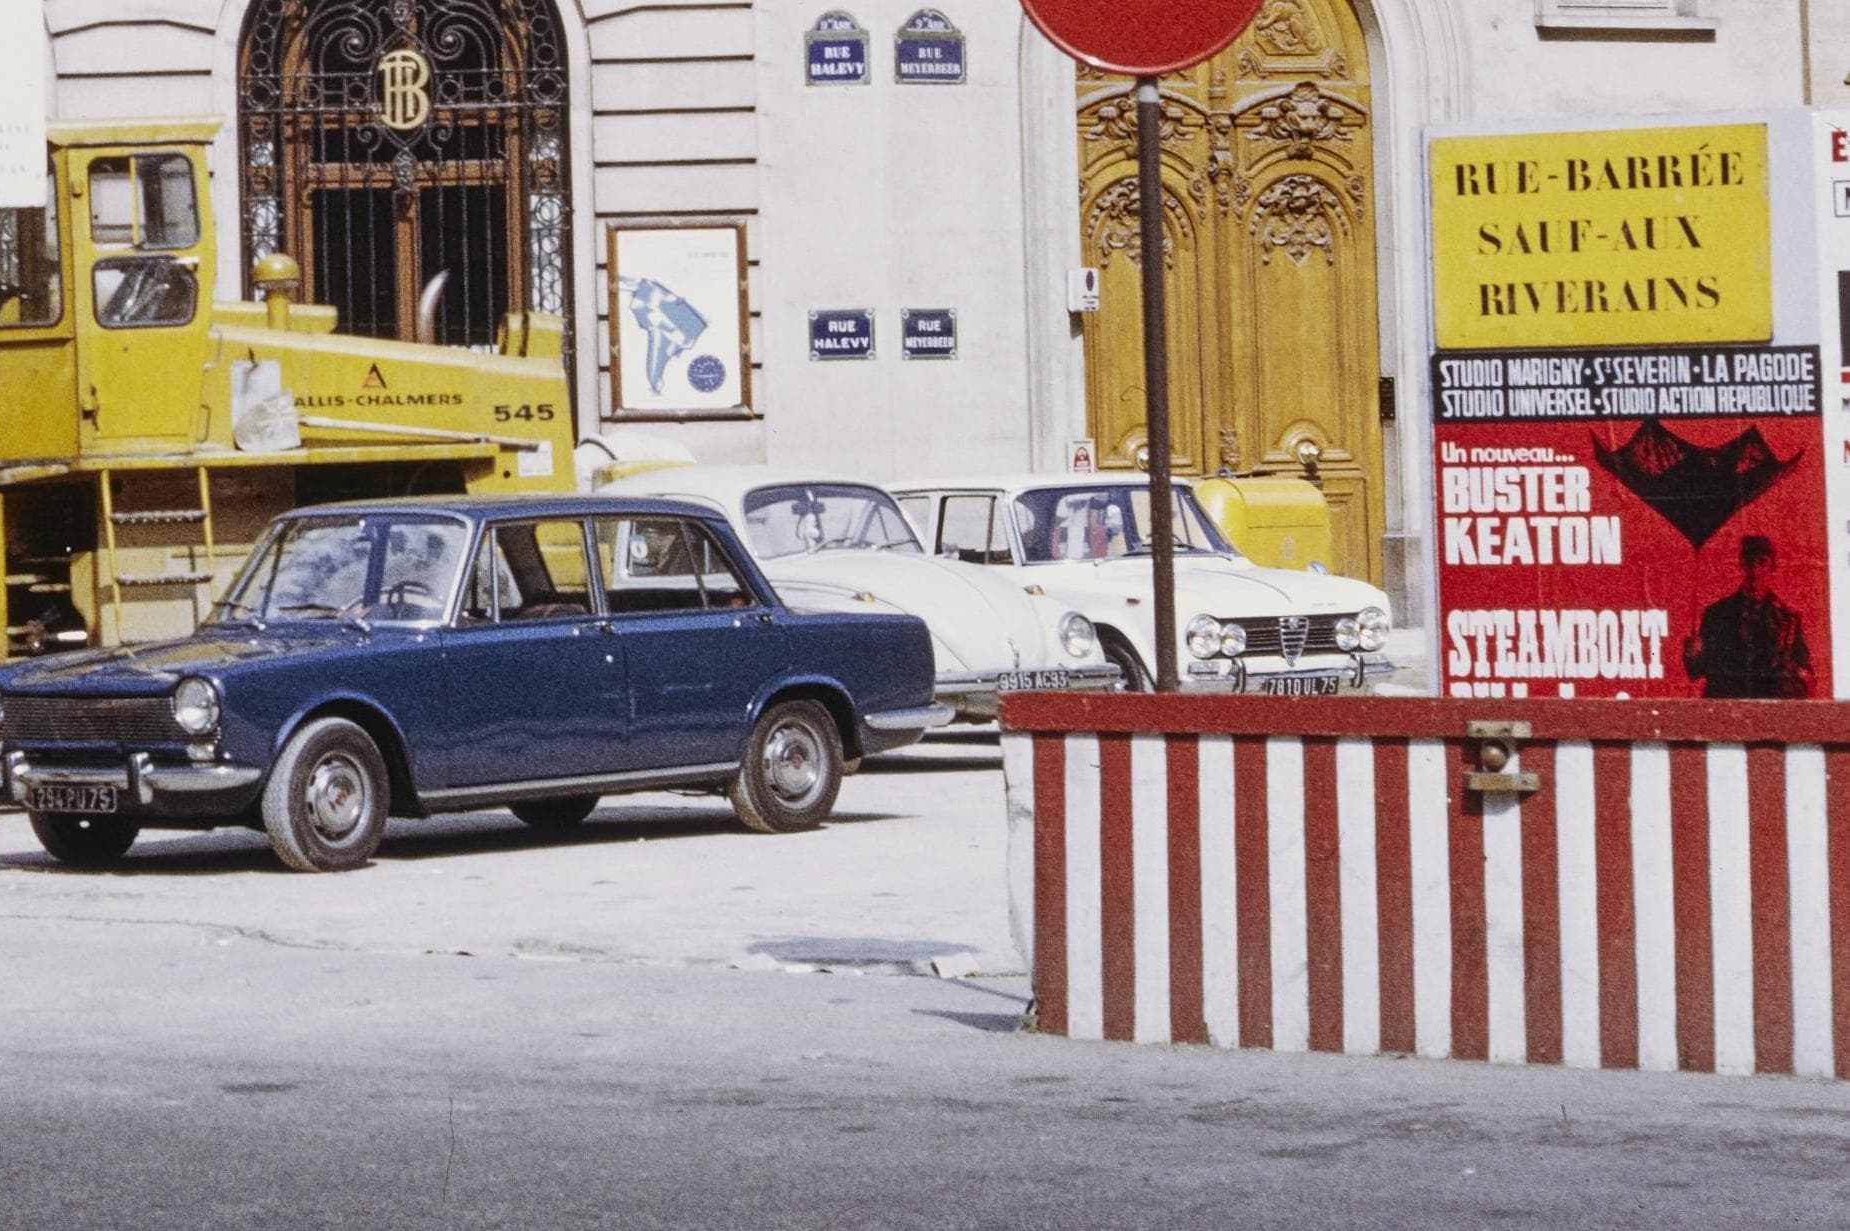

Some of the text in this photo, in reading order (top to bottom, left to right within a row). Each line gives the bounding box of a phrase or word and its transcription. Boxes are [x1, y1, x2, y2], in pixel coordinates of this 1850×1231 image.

[824, 46, 851, 59] RUE
[918, 47, 943, 59] RUE
[810, 62, 865, 76] HALEVY
[900, 62, 961, 75] MEYERBEER
[1478, 276, 1722, 318] RIVERAINS
[828, 320, 856, 333] RUE
[918, 320, 942, 332] RUE
[814, 336, 869, 349] HALEVY
[905, 336, 955, 348] MEYERBEER
[1439, 359, 1504, 389] STUDIO
[1507, 358, 1585, 387] MARIGNY
[1702, 356, 1731, 384] LA
[1734, 353, 1815, 383] PAGODE
[1441, 383, 1816, 419] STUDIO UNIVERSEL STUDIO ACTION REPUBLIQUE
[493, 403, 556, 423] 545
[1441, 441, 1468, 464] Un
[1442, 465, 1592, 515] BUSTER
[1443, 516, 1623, 566] KEATON
[1446, 608, 1669, 679] STEAMBOAT
